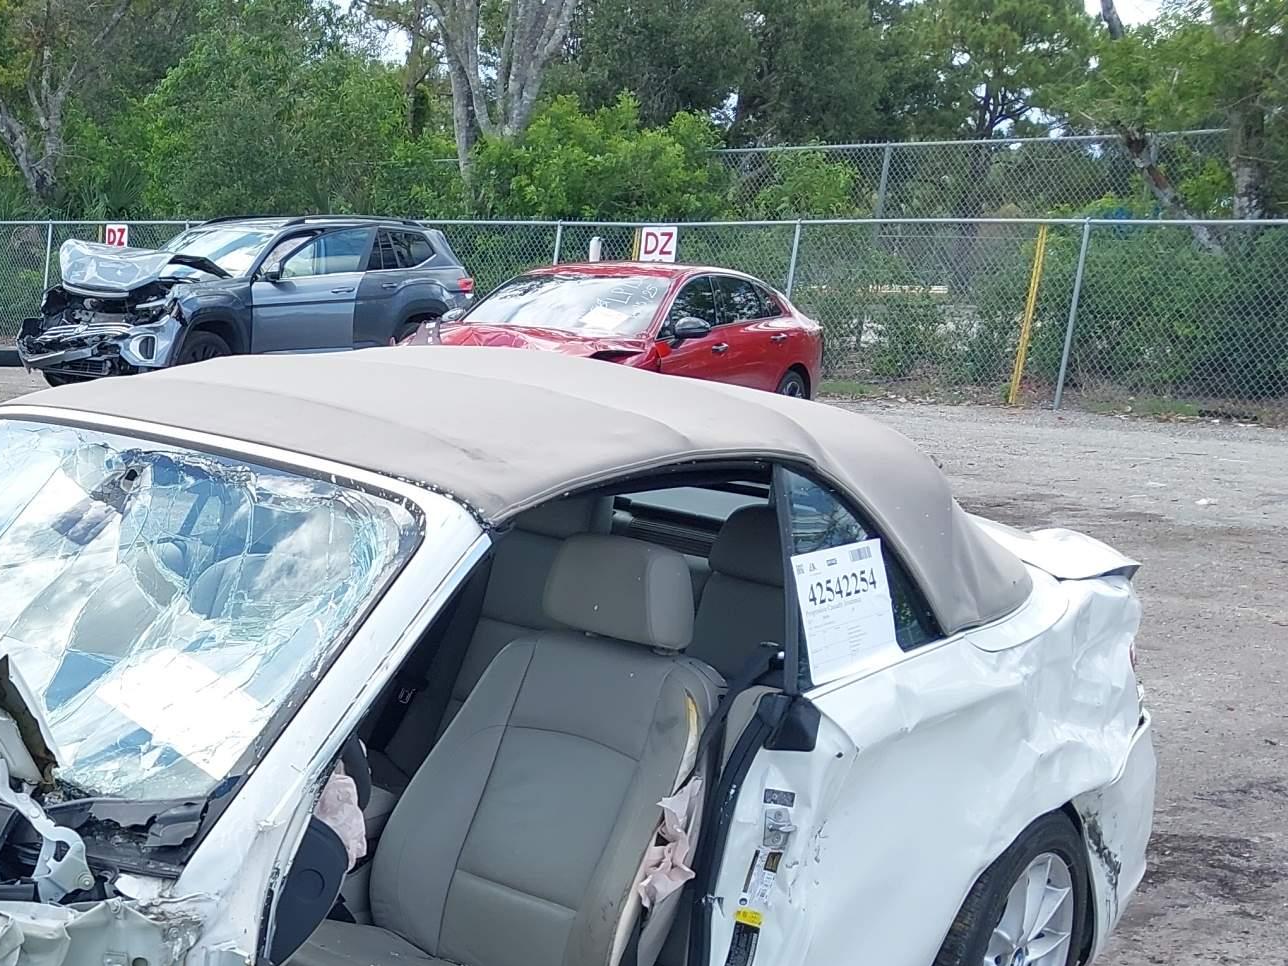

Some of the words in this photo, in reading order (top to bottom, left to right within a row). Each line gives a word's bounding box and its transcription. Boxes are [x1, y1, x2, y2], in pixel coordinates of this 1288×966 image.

[107, 228, 126, 246] DZ
[643, 231, 674, 255] DZ
[808, 567, 877, 606] 42542254
